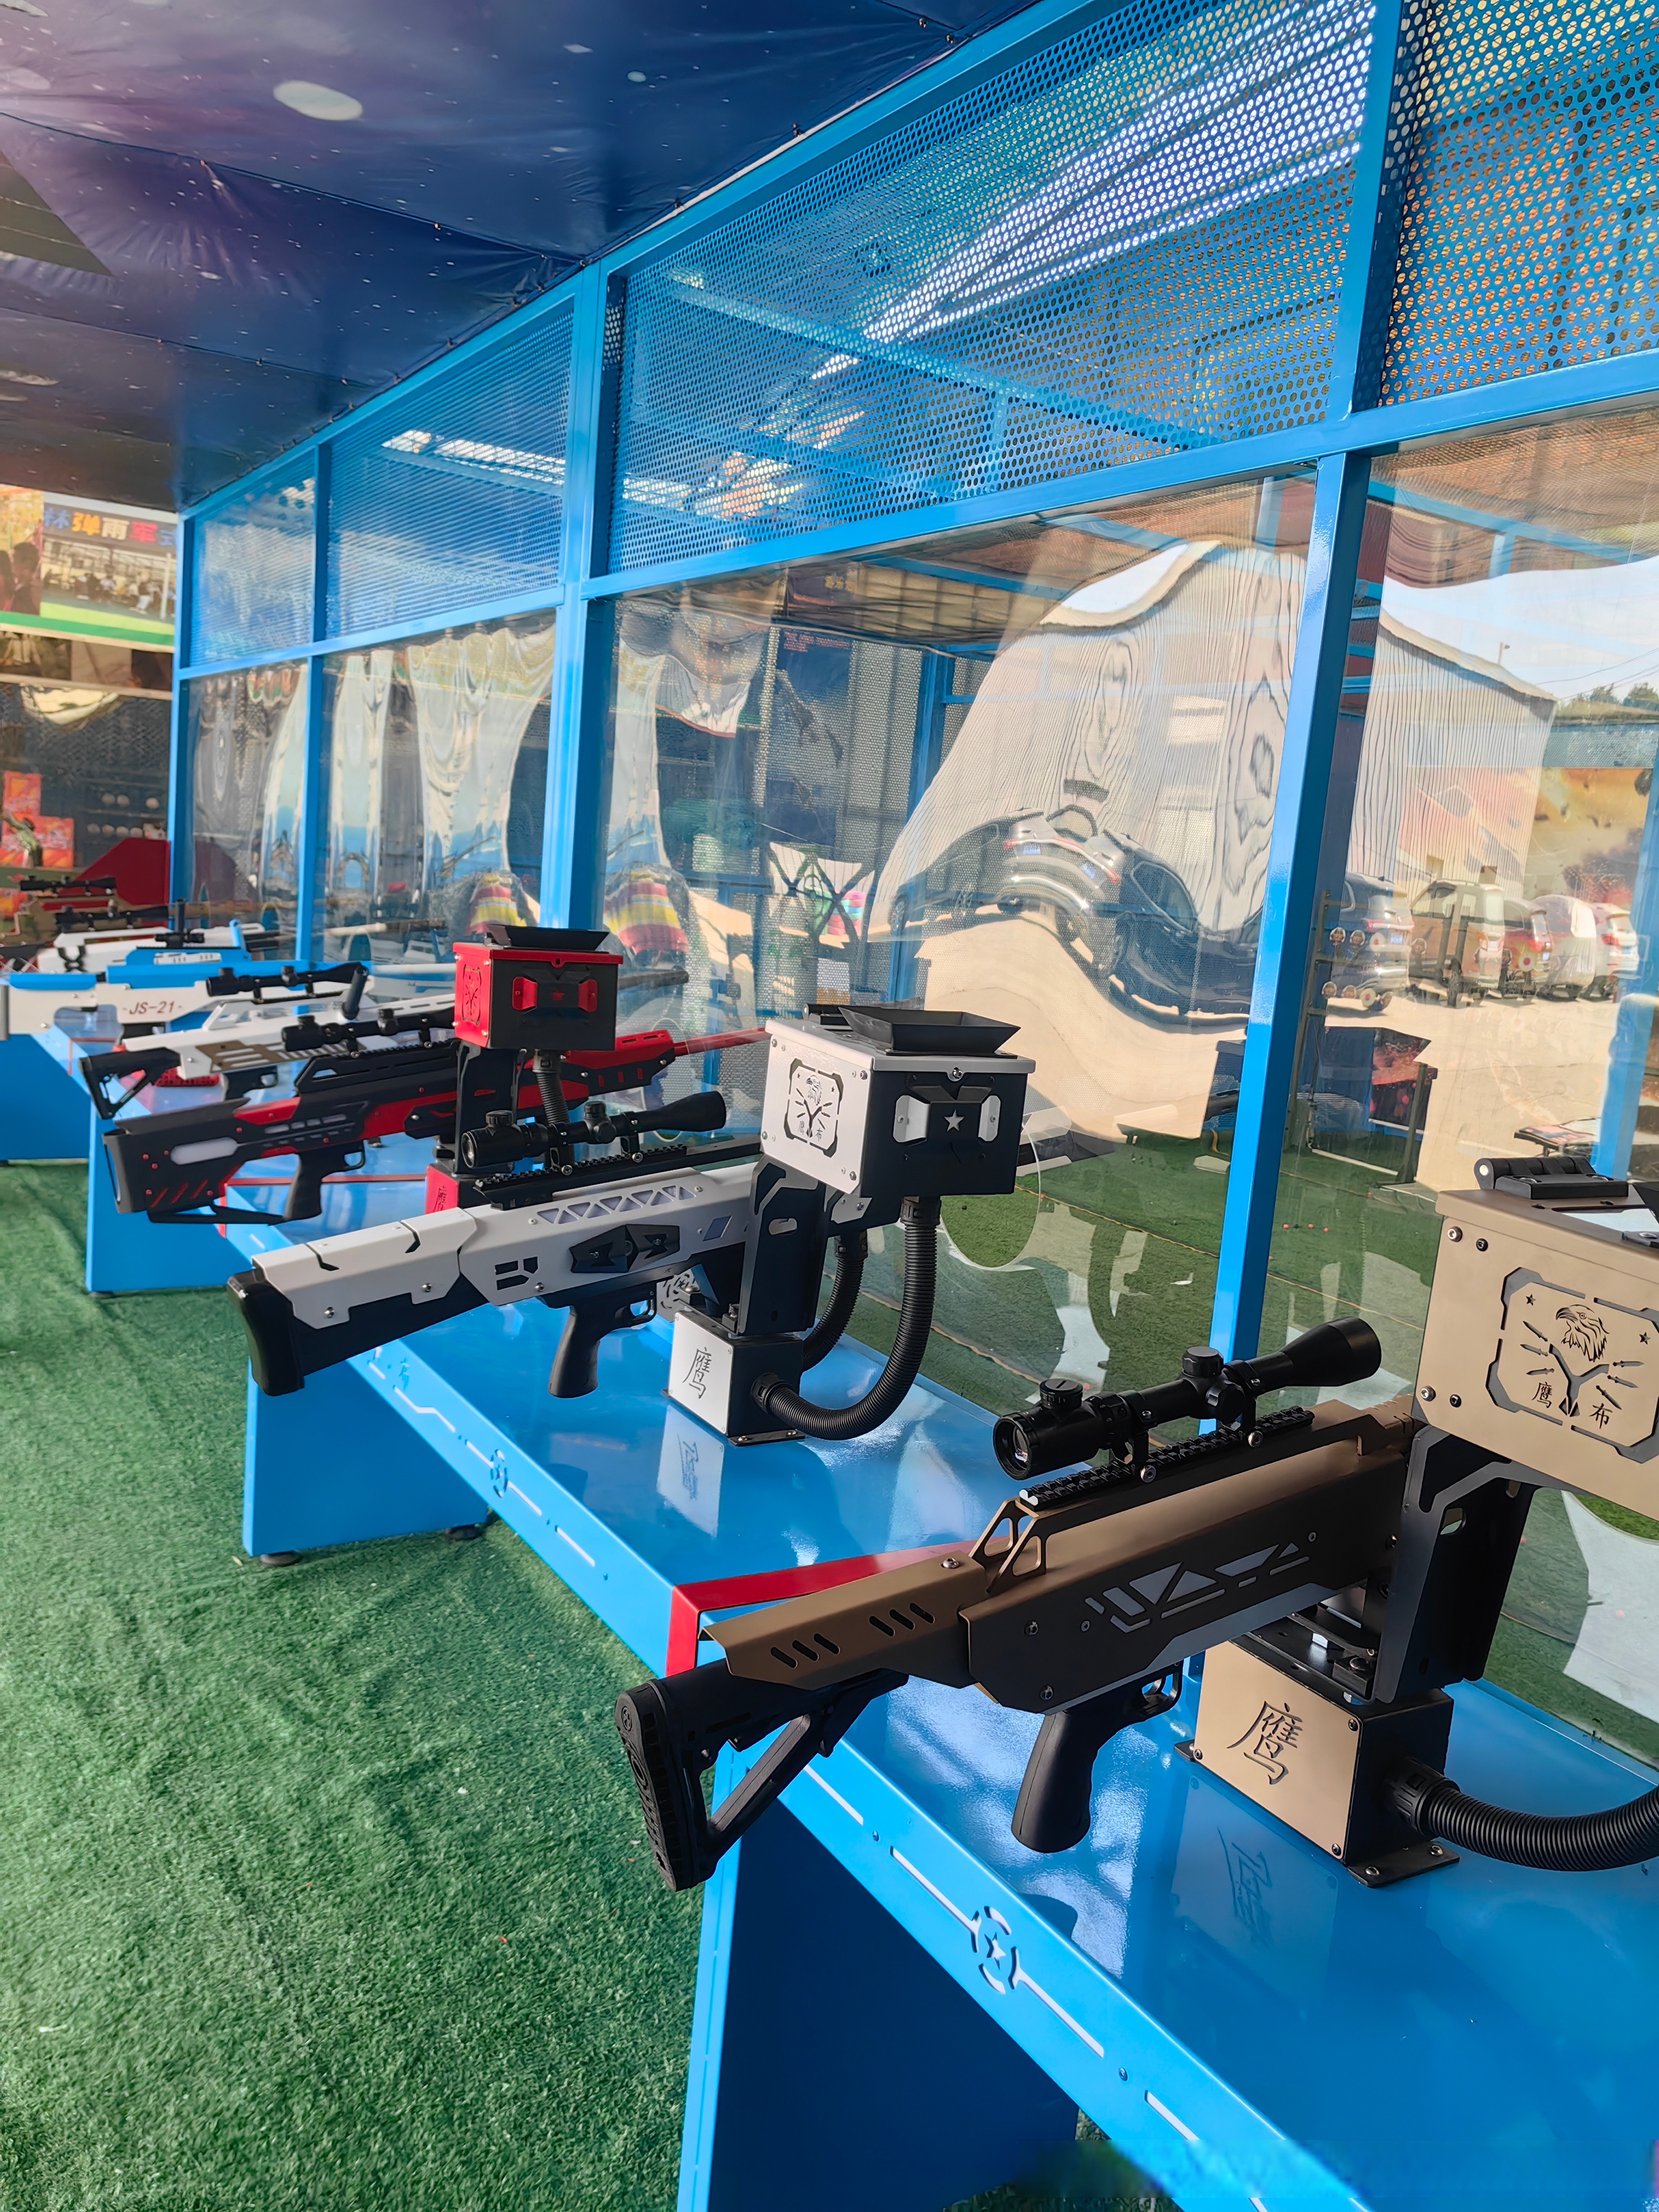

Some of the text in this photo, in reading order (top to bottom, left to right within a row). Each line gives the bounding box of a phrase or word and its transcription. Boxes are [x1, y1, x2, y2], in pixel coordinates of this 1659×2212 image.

[682, 1346, 712, 1399] 鹰
[1531, 1381, 1613, 1429] 鹰 布
[1226, 1702, 1303, 1785] 鹰
